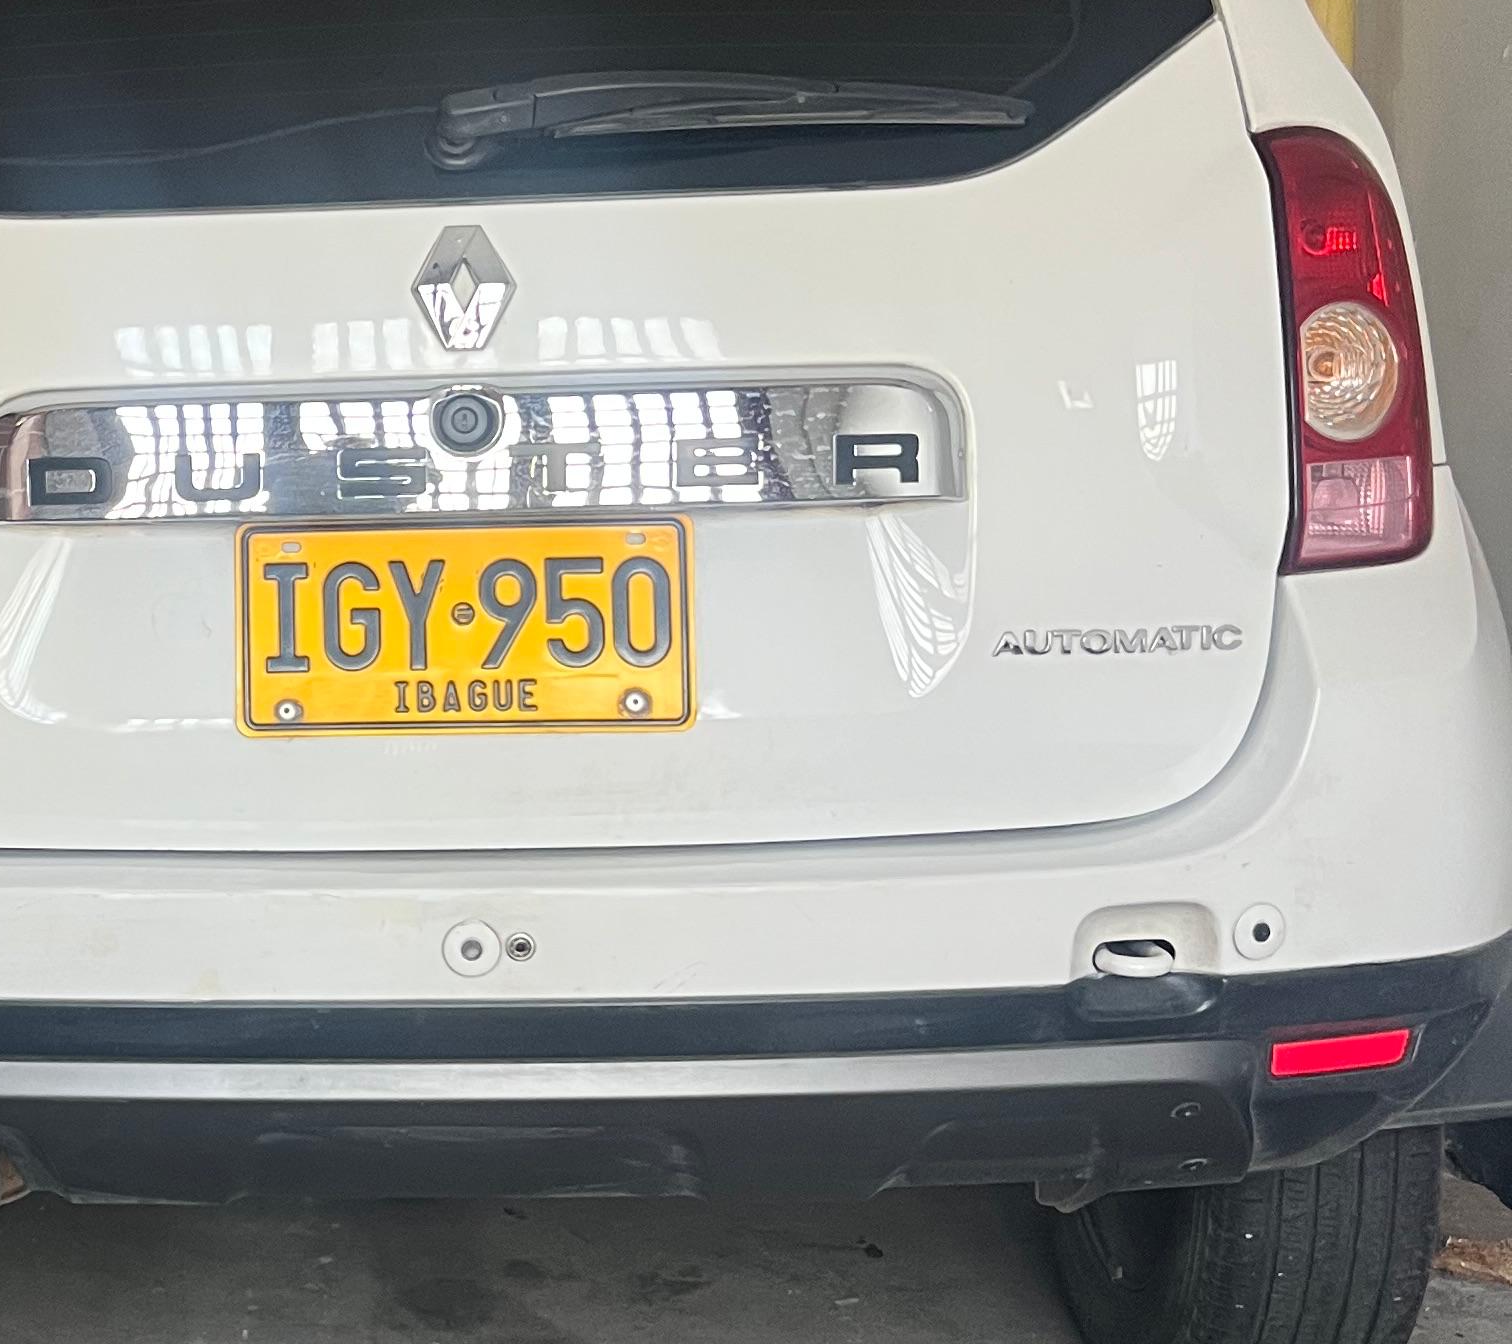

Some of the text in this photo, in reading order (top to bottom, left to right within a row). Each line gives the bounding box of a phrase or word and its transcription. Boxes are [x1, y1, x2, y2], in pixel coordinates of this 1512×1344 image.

[27, 432, 920, 507] DUSTER
[992, 624, 1243, 657] AUTOMATIC
[394, 678, 539, 714] IBAGUE
